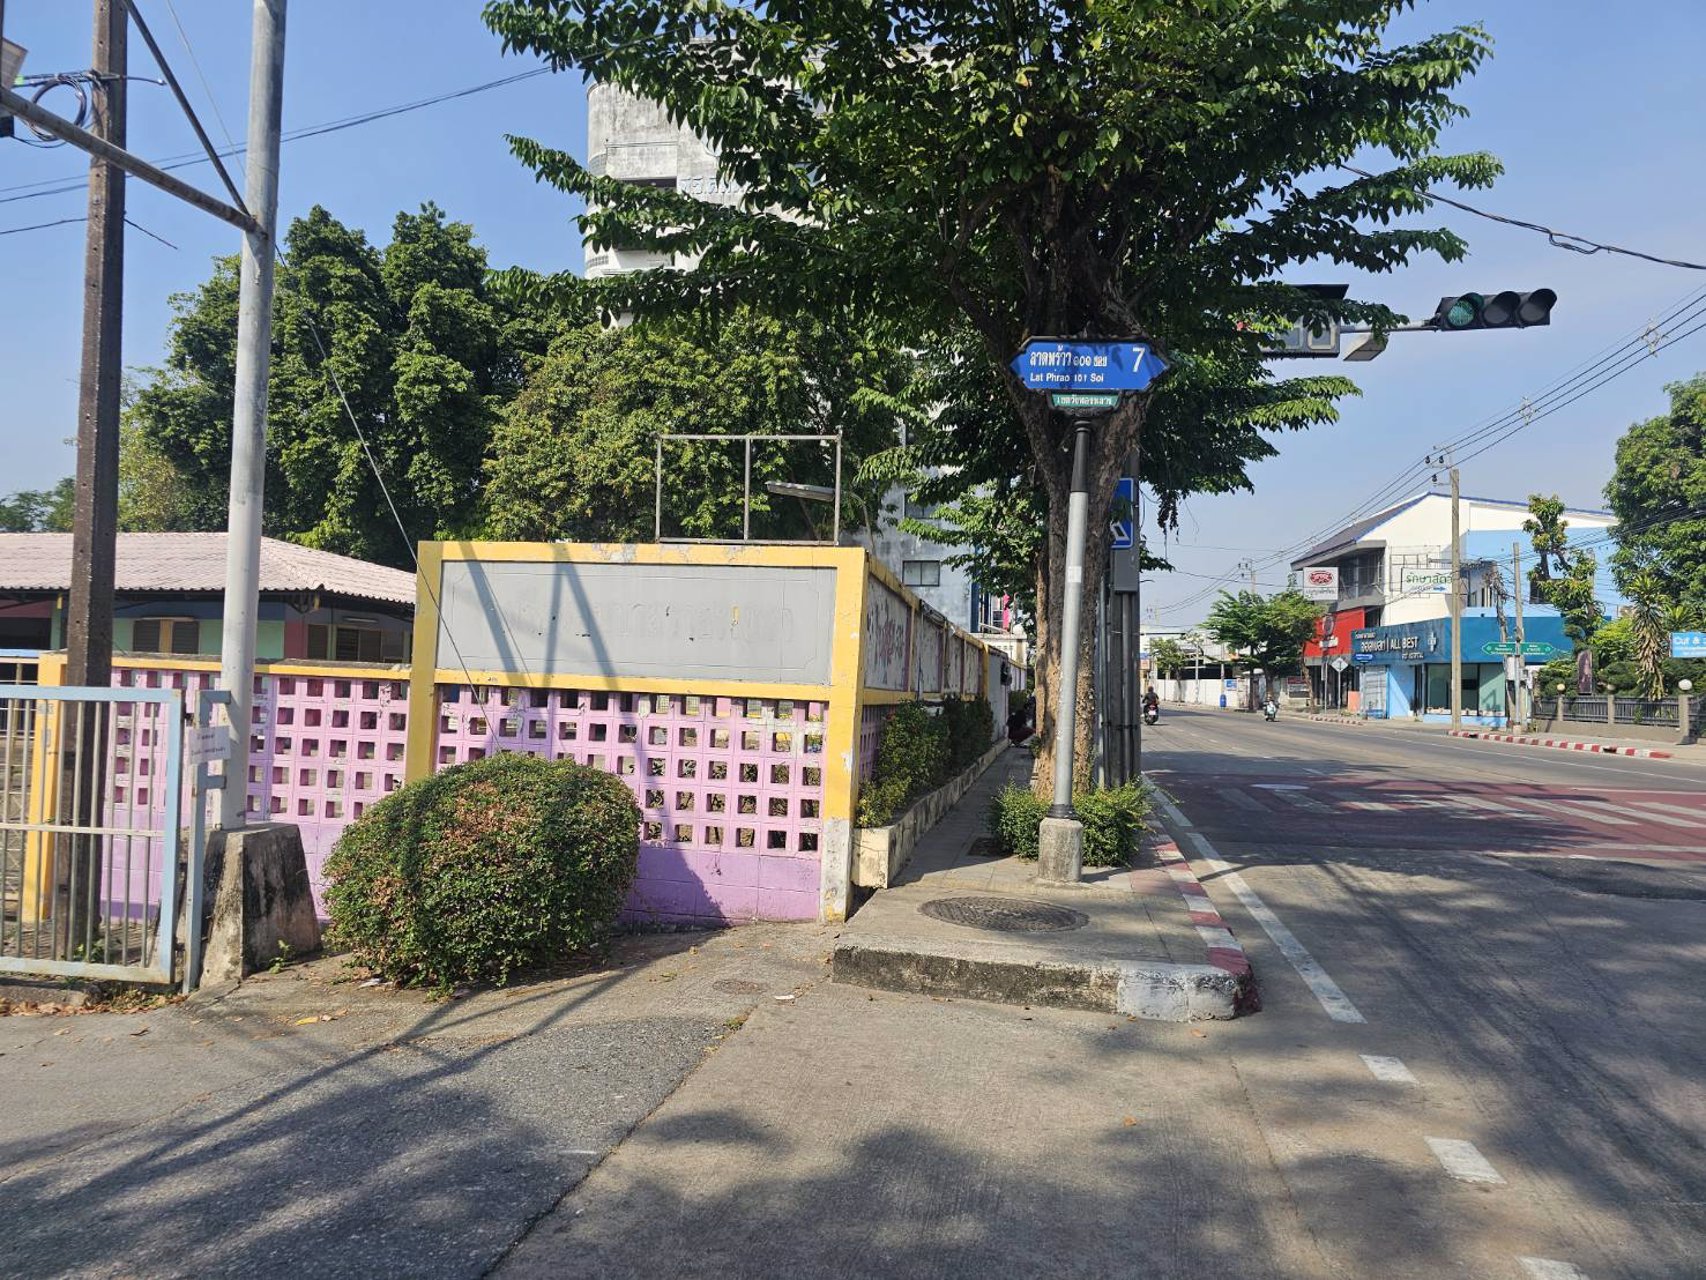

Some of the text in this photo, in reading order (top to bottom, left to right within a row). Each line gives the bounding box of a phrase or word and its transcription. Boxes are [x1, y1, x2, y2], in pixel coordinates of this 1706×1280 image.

[1030, 344, 1072, 367] ลาดพร้าว
[1132, 347, 1145, 373] 7
[1030, 372, 1104, 382] Lat Phrao 101 Soi
[1390, 636, 1418, 650] ALL BEST
